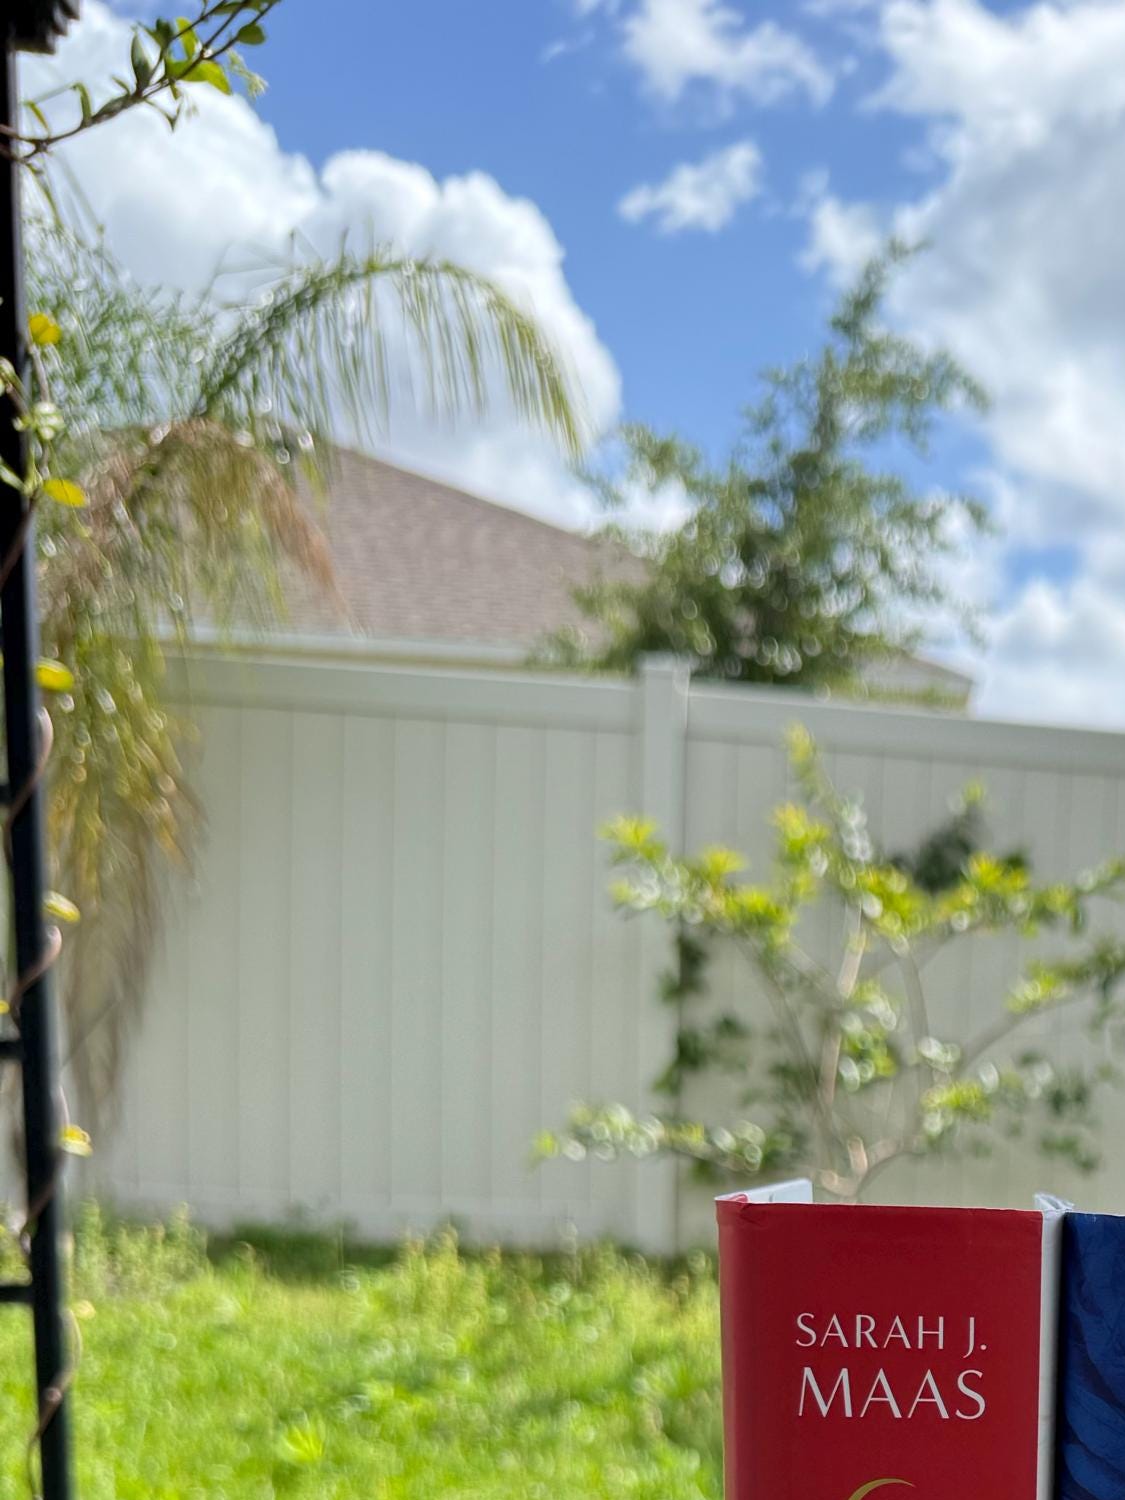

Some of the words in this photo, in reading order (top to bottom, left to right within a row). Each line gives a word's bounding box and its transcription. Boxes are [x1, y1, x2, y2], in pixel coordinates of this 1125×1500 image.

[795, 1312, 944, 1350] SARAH
[963, 1316, 987, 1359] J.
[798, 1366, 986, 1420] MAAS
